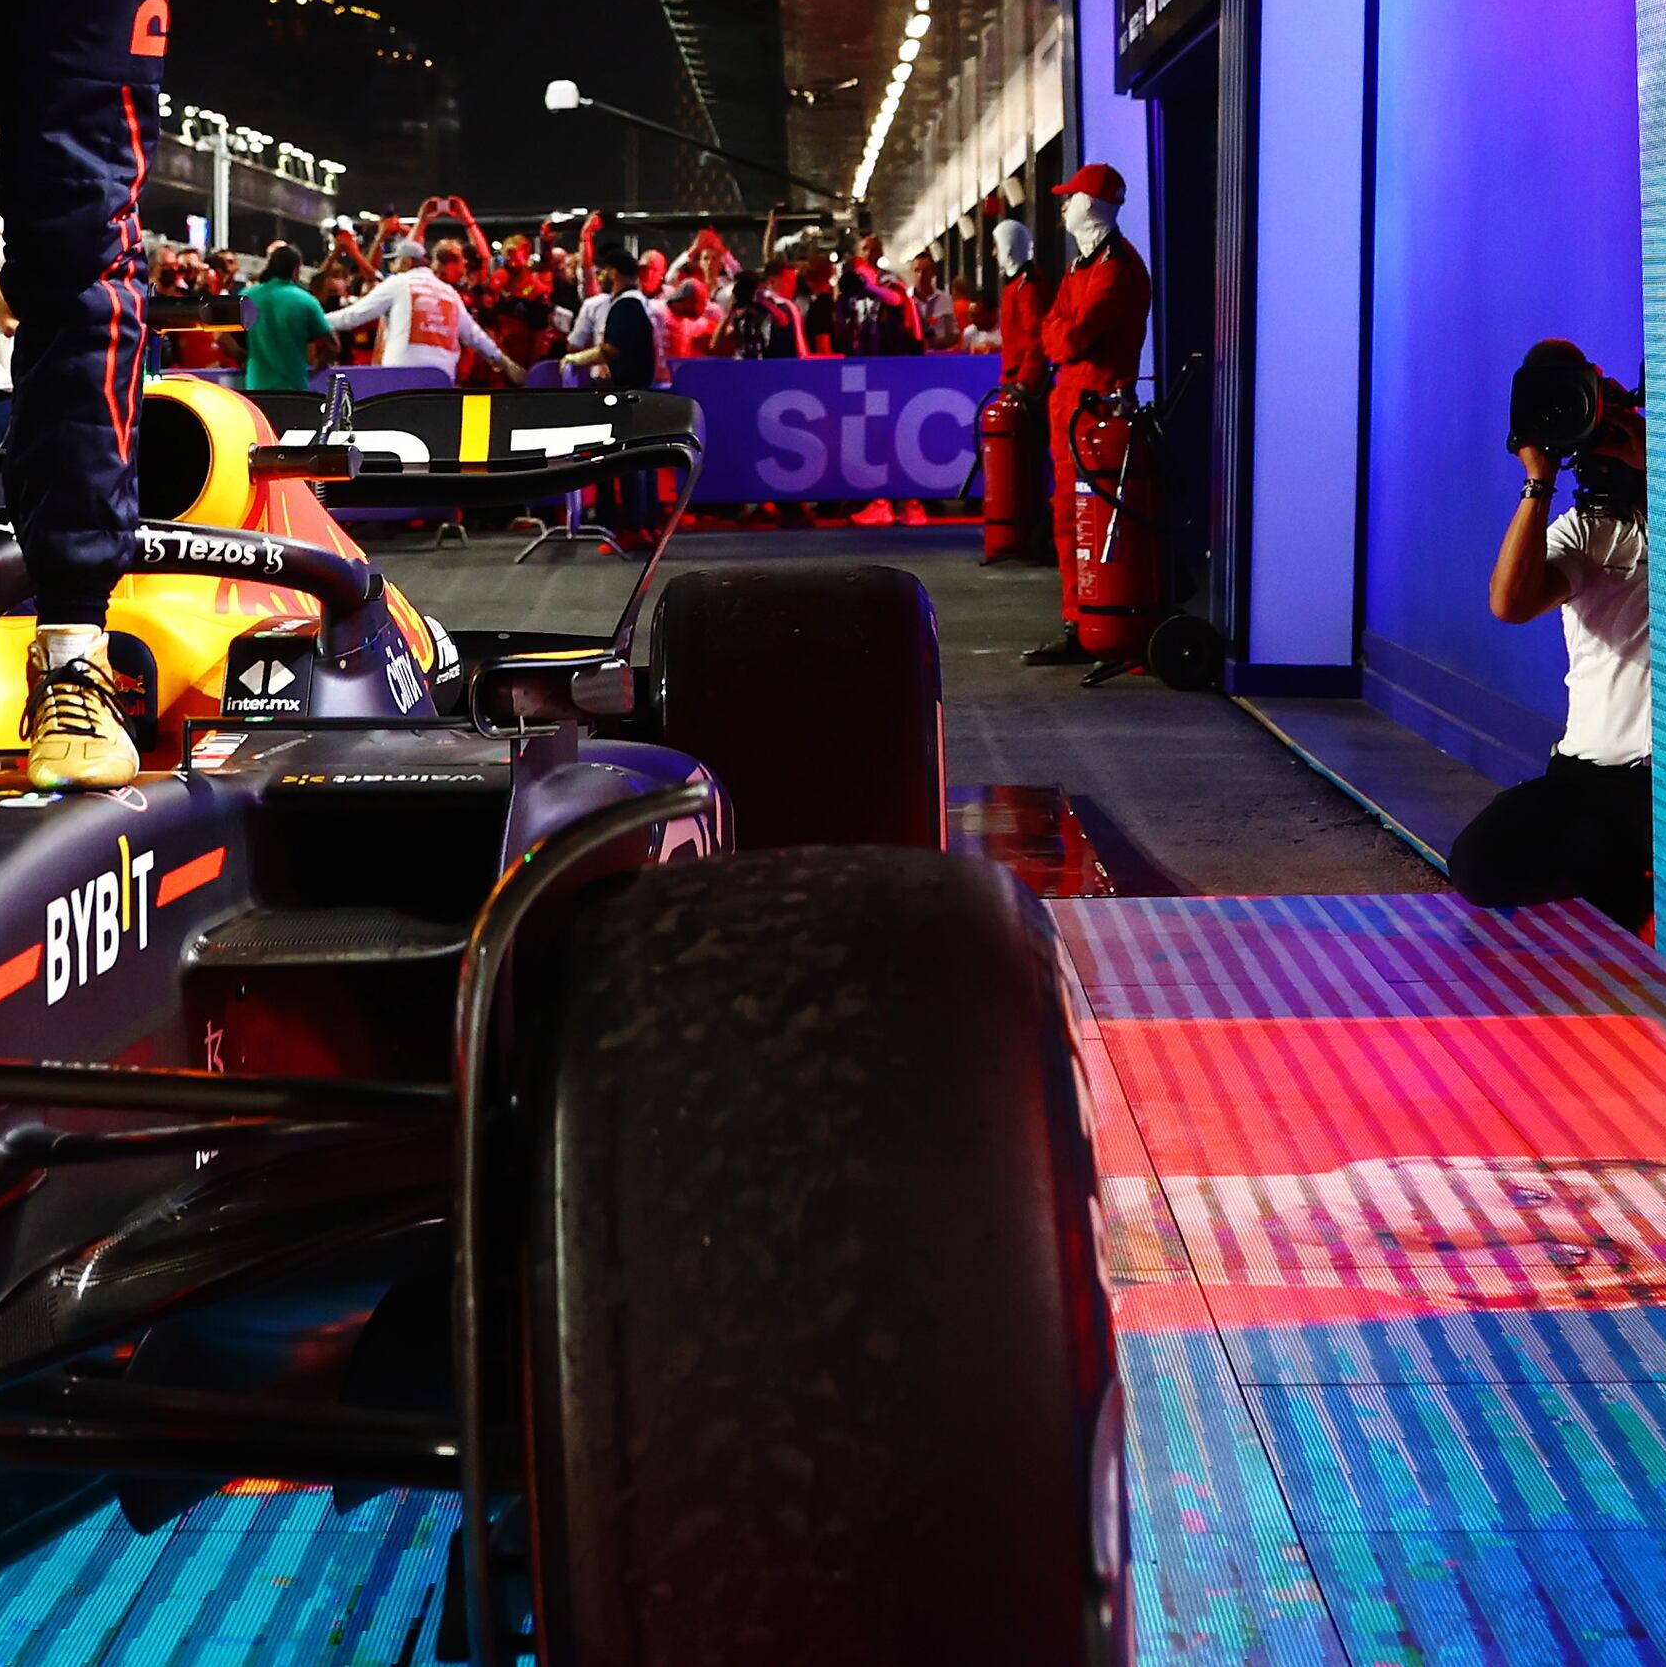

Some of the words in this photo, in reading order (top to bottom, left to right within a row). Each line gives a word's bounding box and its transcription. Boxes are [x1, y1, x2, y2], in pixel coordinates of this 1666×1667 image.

[756, 365, 977, 493] stc
[176, 531, 257, 566] Tezos
[226, 696, 301, 712] inter.mx
[46, 836, 155, 1006] BYBIT
